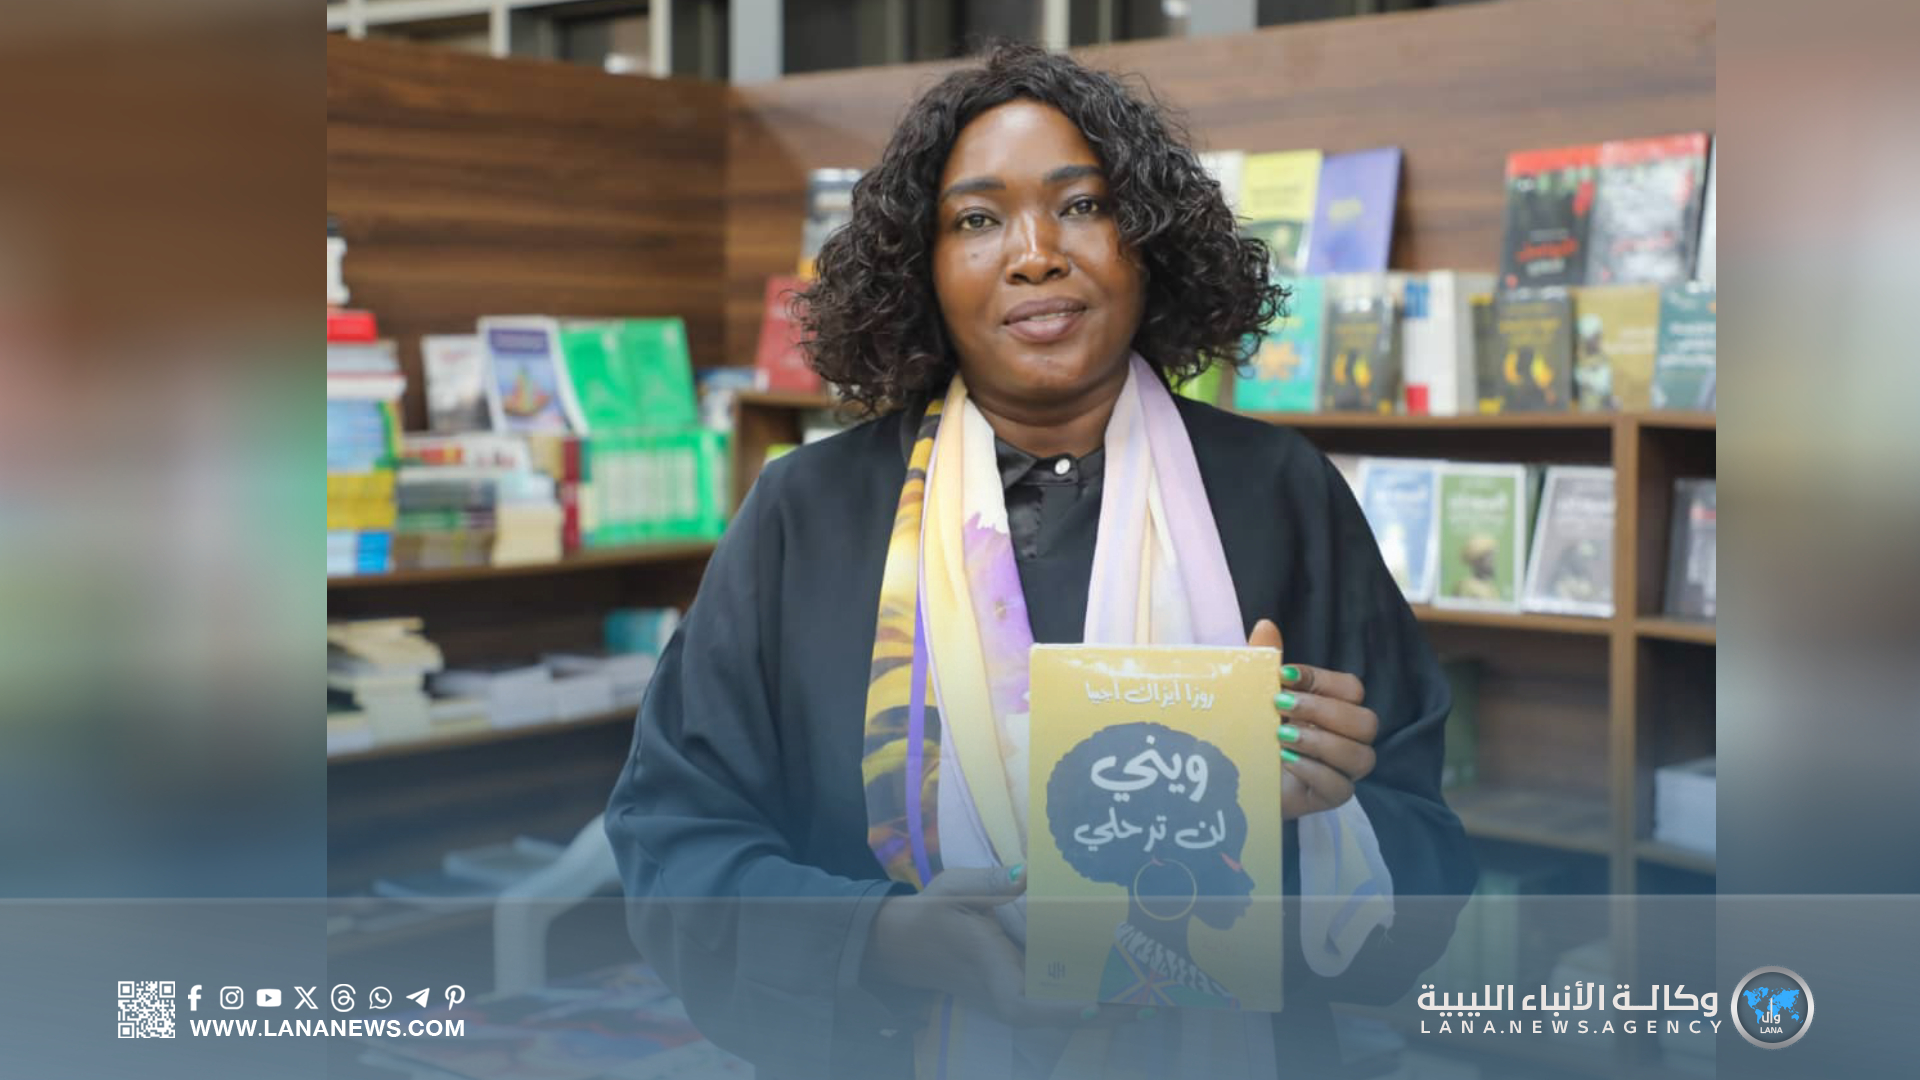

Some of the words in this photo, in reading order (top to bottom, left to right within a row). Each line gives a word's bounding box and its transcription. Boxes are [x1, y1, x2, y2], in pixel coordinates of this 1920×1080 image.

[1185, 683, 1215, 709] روزا
[1090, 734, 1209, 803] ويني
[1073, 806, 1168, 852] ترحلي
[1174, 809, 1226, 849] لن
